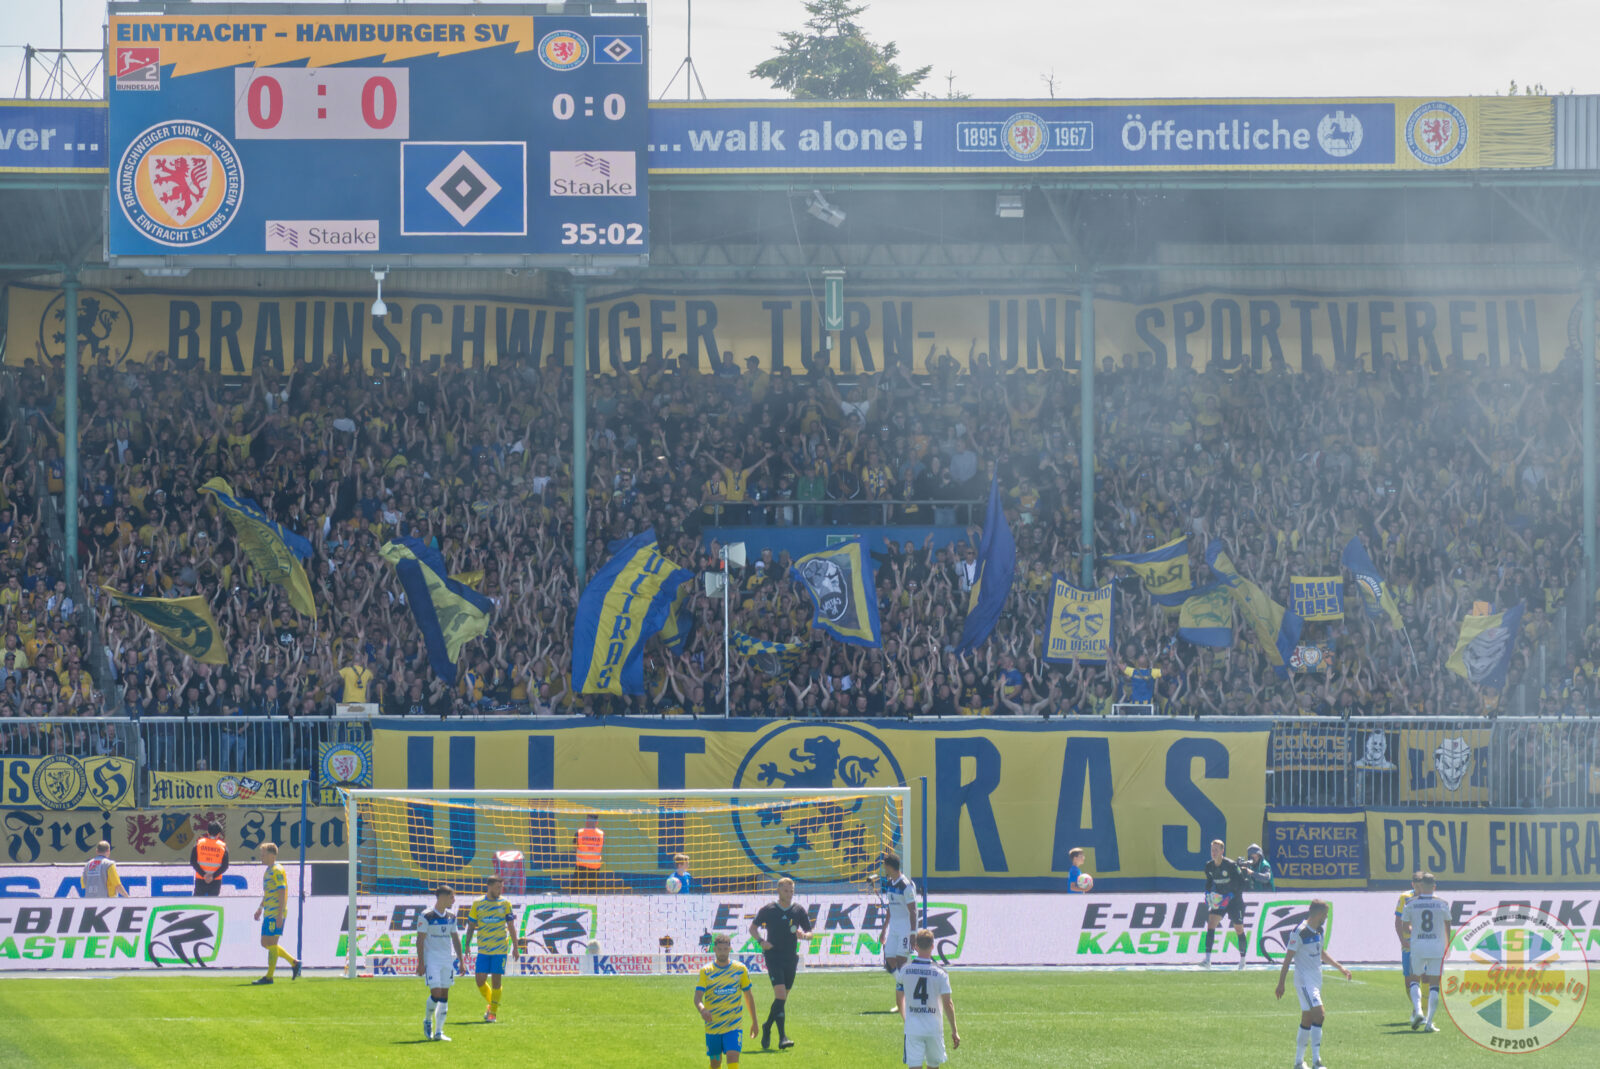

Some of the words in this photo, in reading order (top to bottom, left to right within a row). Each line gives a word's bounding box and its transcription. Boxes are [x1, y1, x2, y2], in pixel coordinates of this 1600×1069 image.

[117, 24, 267, 41] EINTRACHT
[296, 24, 465, 42] HAMBURGER
[474, 24, 510, 42] SV
[145, 65, 158, 80] 2
[247, 75, 284, 129] 0
[360, 75, 397, 129] 0
[688, 120, 786, 151] walk
[798, 120, 923, 151] alone!
[963, 127, 997, 146] 1895
[1054, 127, 1087, 146] 1967
[1121, 113, 1311, 151] Öffentliche
[122, 127, 170, 208] BRAUNSCHWEIGER
[203, 131, 212, 145] U.
[212, 140, 239, 206] SPORTVEREIN
[553, 178, 632, 195] Staake
[136, 213, 189, 241] EINTRACHT
[191, 227, 208, 240] E.V.
[206, 213, 226, 232] 1895
[308, 227, 377, 245] Staake
[561, 222, 643, 245] 35:02
[168, 300, 722, 374] BRAUNSCHWEIGER
[762, 300, 935, 372] TURN-
[989, 298, 1095, 370] UND
[1135, 298, 1541, 371] SPORTVEREIN
[264, 778, 306, 798] Alle
[1275, 824, 1358, 840] STÄRKER
[1276, 844, 1310, 858] ALS
[1313, 844, 1360, 858] EURE
[1383, 819, 1468, 873] BTSV
[1277, 862, 1360, 876] VERBOTE
[1421, 909, 1434, 932] 8
[1076, 930, 1252, 955] KASTEN
[913, 977, 929, 1005] 4
